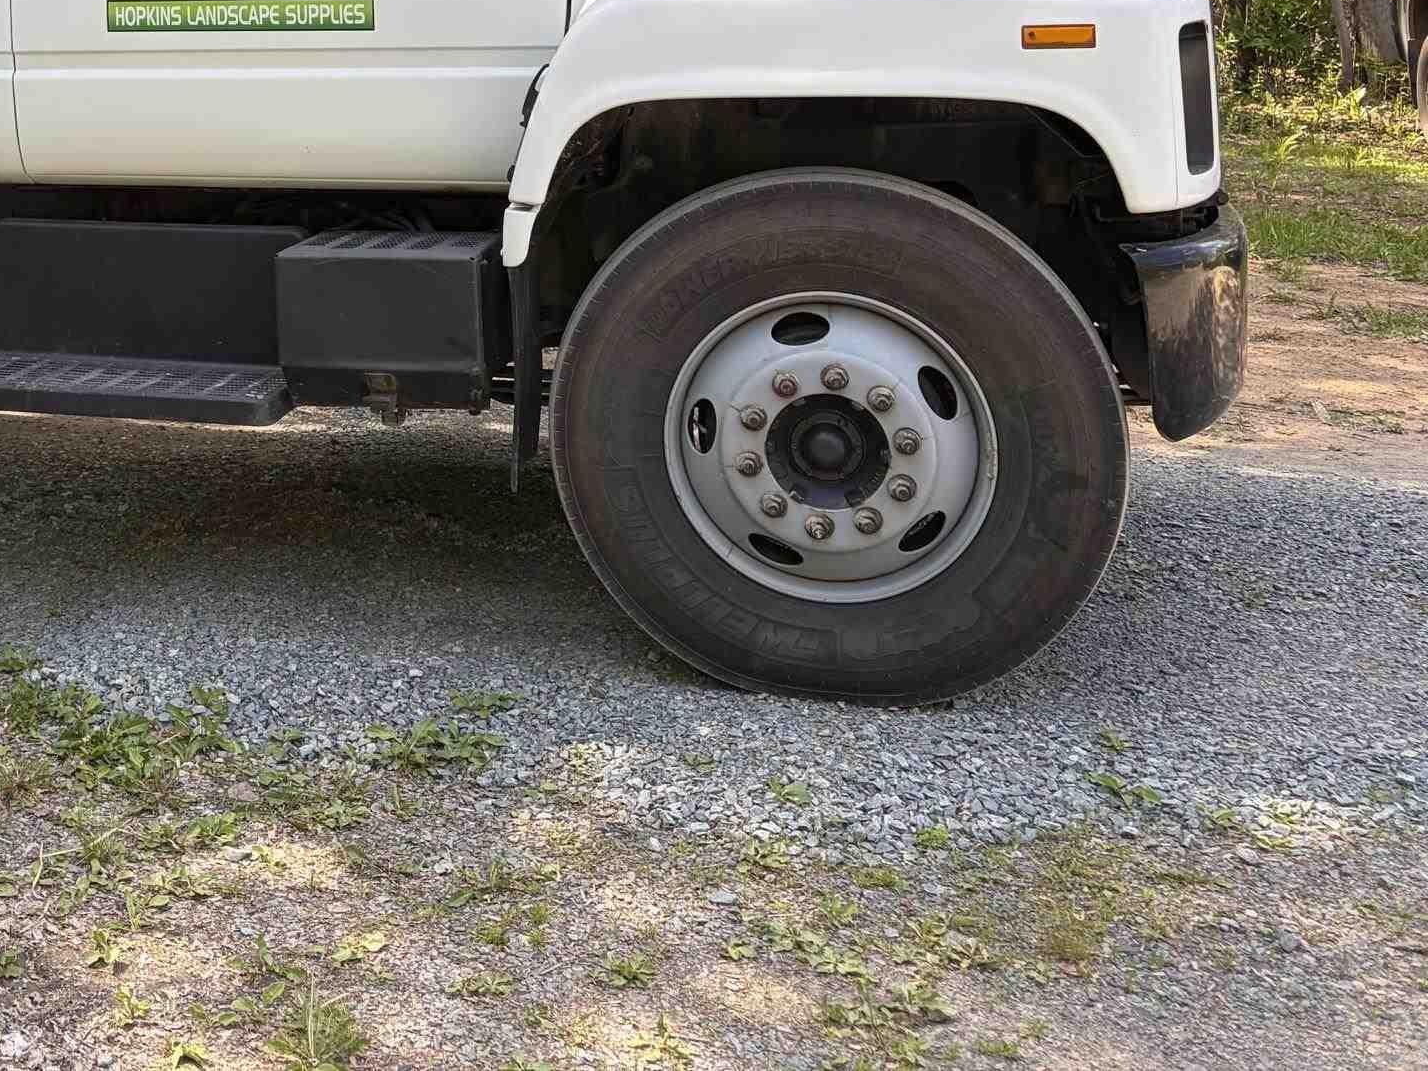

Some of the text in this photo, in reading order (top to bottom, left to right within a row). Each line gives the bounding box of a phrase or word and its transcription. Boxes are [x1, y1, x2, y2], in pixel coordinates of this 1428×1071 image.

[115, 3, 366, 26] HOPKINS LANDSCAPE SUPPLIES
